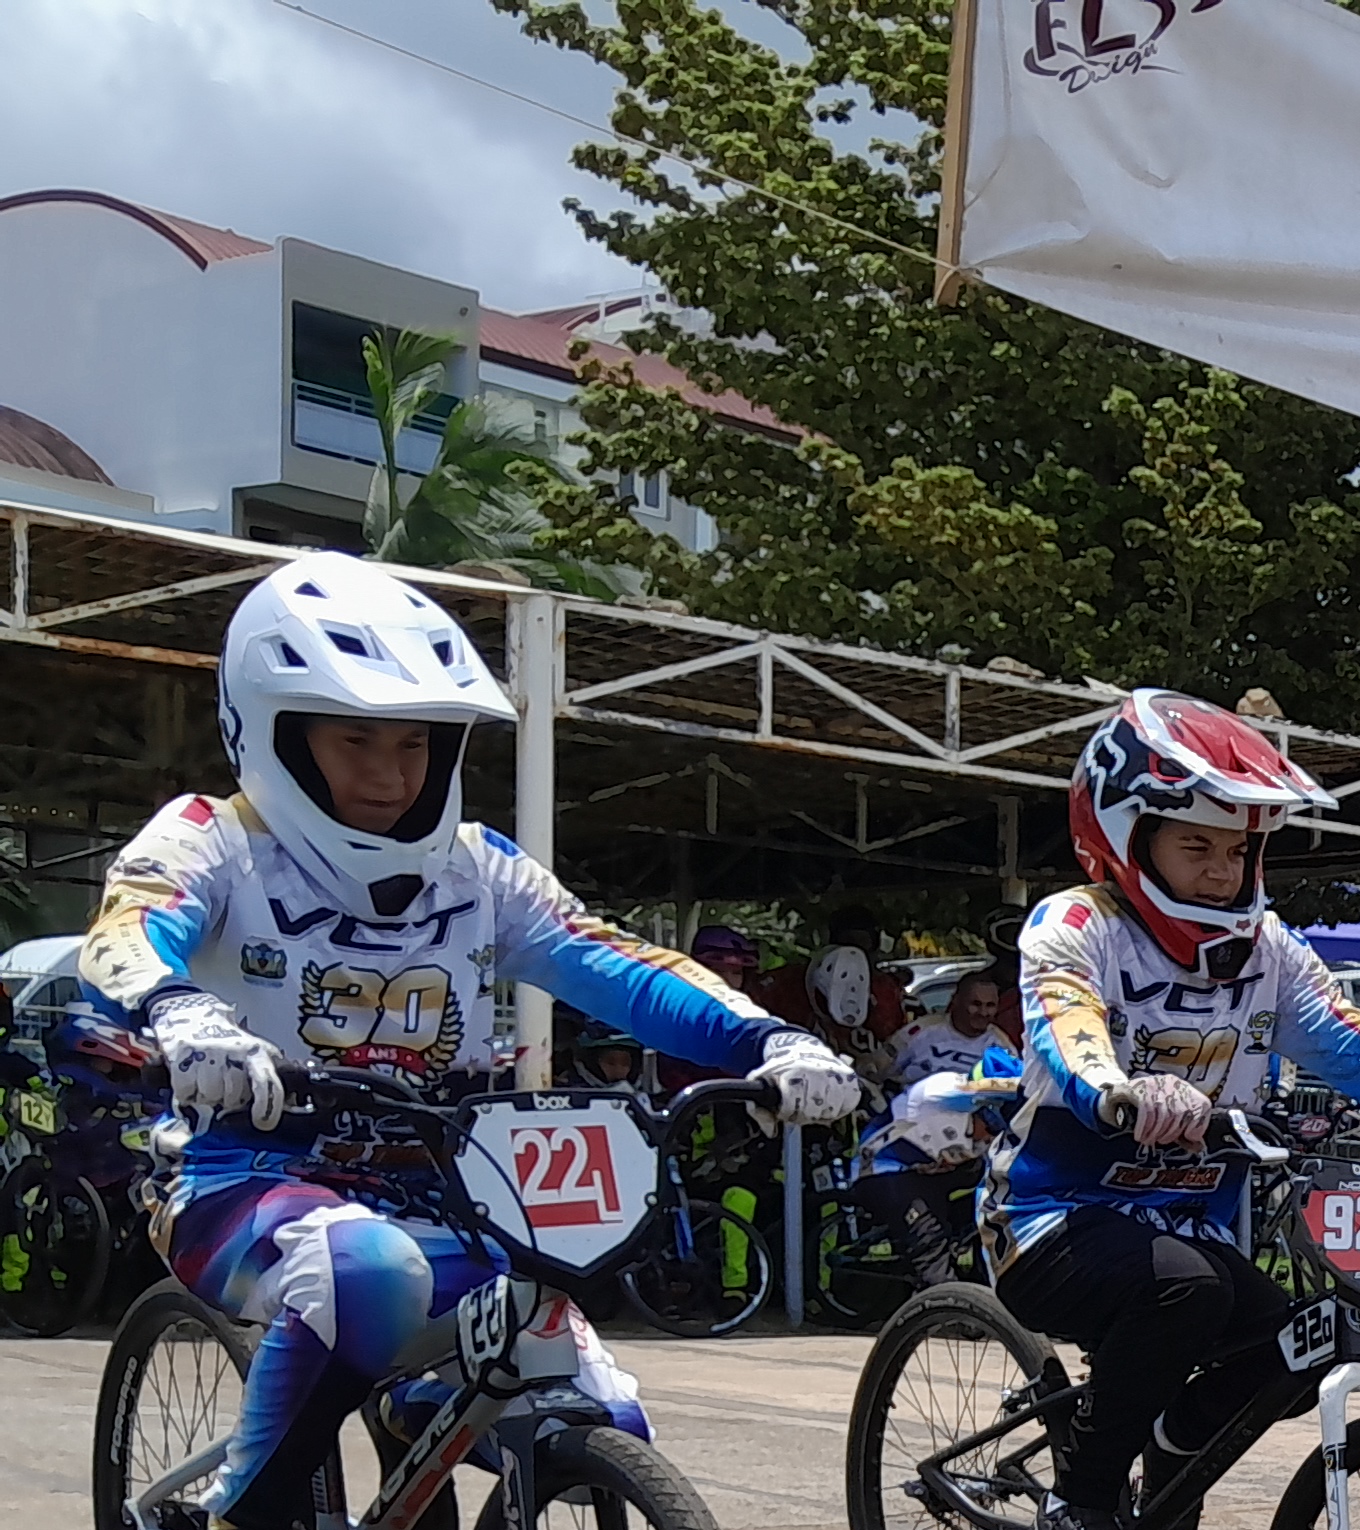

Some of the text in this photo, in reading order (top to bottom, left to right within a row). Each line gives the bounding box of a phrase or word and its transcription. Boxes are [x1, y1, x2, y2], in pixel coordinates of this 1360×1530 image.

[268, 897, 479, 952] VCT
[300, 963, 453, 1053] 30
[1120, 970, 1265, 1015] VCT
[366, 1046, 398, 1060] ANS
[533, 1092, 571, 1110] box
